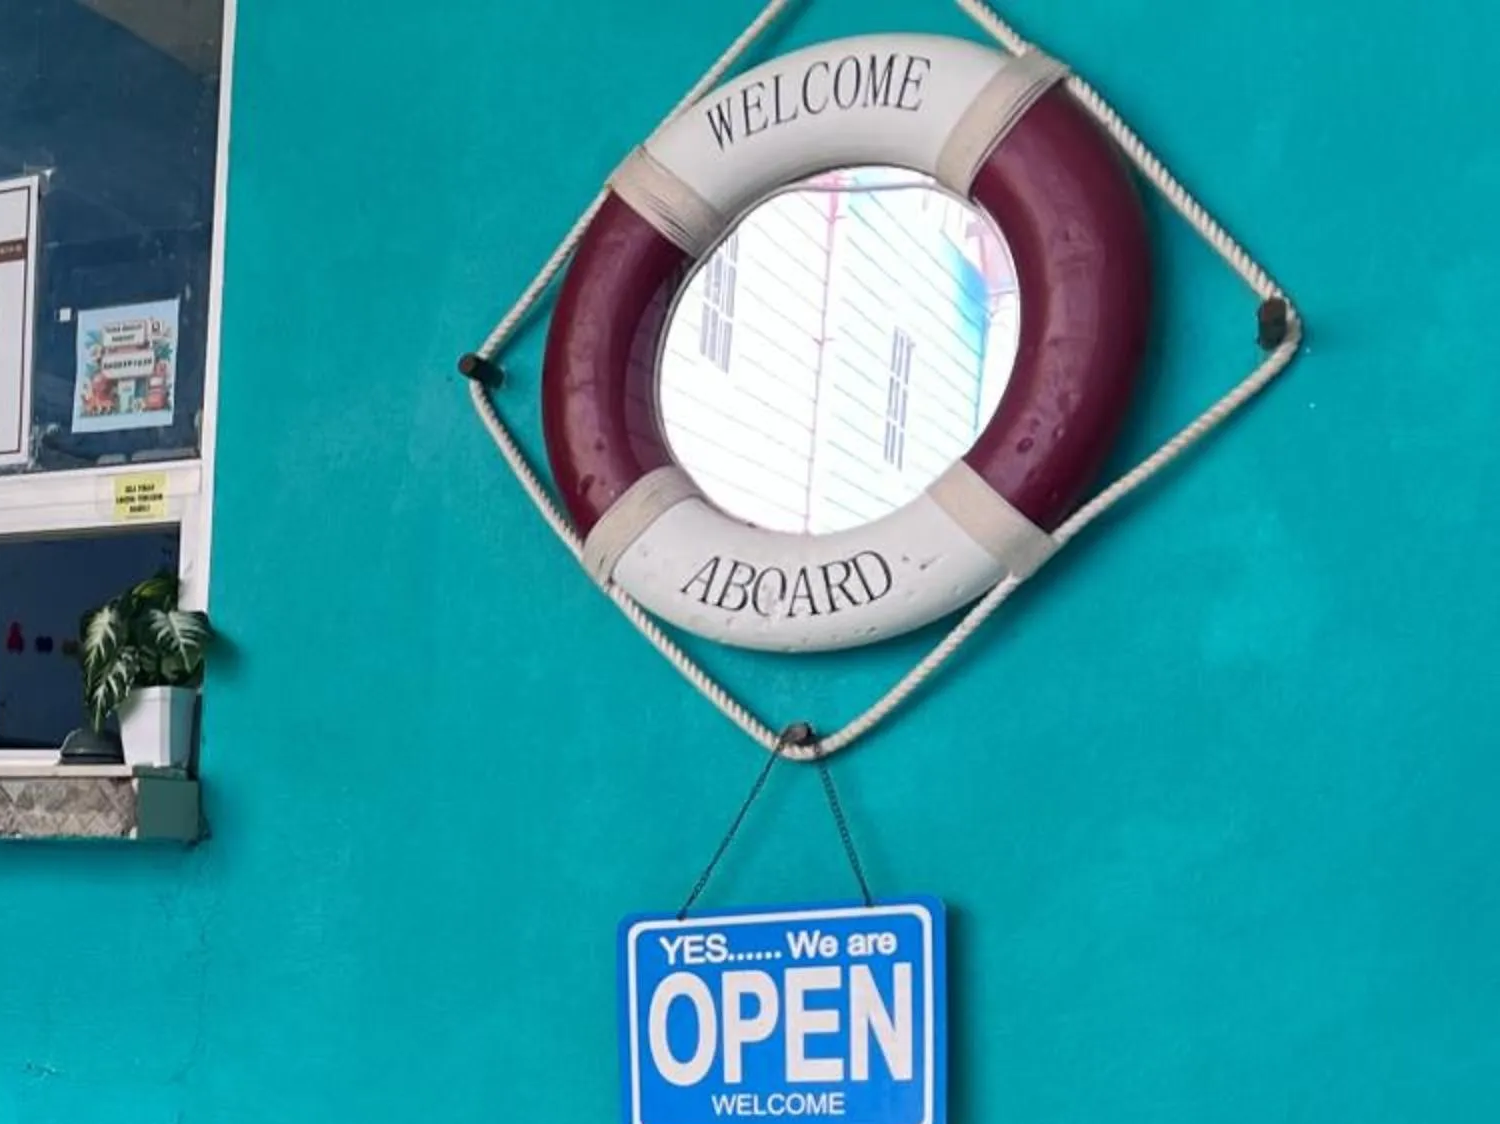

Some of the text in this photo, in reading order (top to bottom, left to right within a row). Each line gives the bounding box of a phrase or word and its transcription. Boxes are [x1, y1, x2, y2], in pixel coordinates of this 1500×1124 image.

[705, 51, 932, 153] WELCOME
[680, 549, 894, 620] ABOARD
[786, 929, 838, 960] We
[847, 930, 898, 956] are
[648, 961, 913, 1087] OPEN
[711, 1092, 846, 1118] WELCOME
